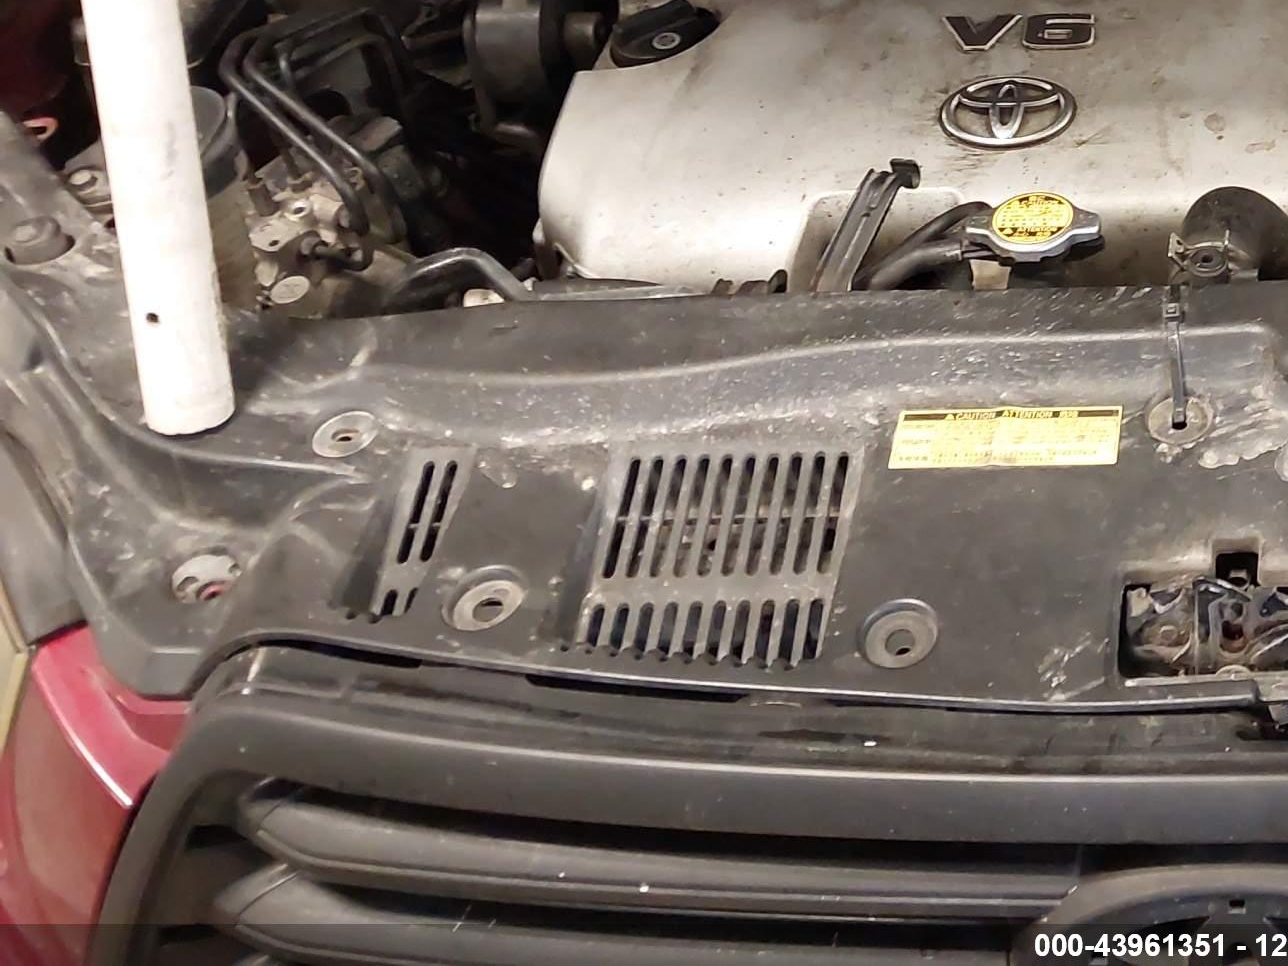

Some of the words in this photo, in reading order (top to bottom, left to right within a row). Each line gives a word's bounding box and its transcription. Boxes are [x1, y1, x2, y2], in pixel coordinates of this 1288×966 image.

[941, 13, 1096, 52] V6
[955, 411, 996, 420] CAUTION
[1001, 409, 1053, 419] ATTENTION
